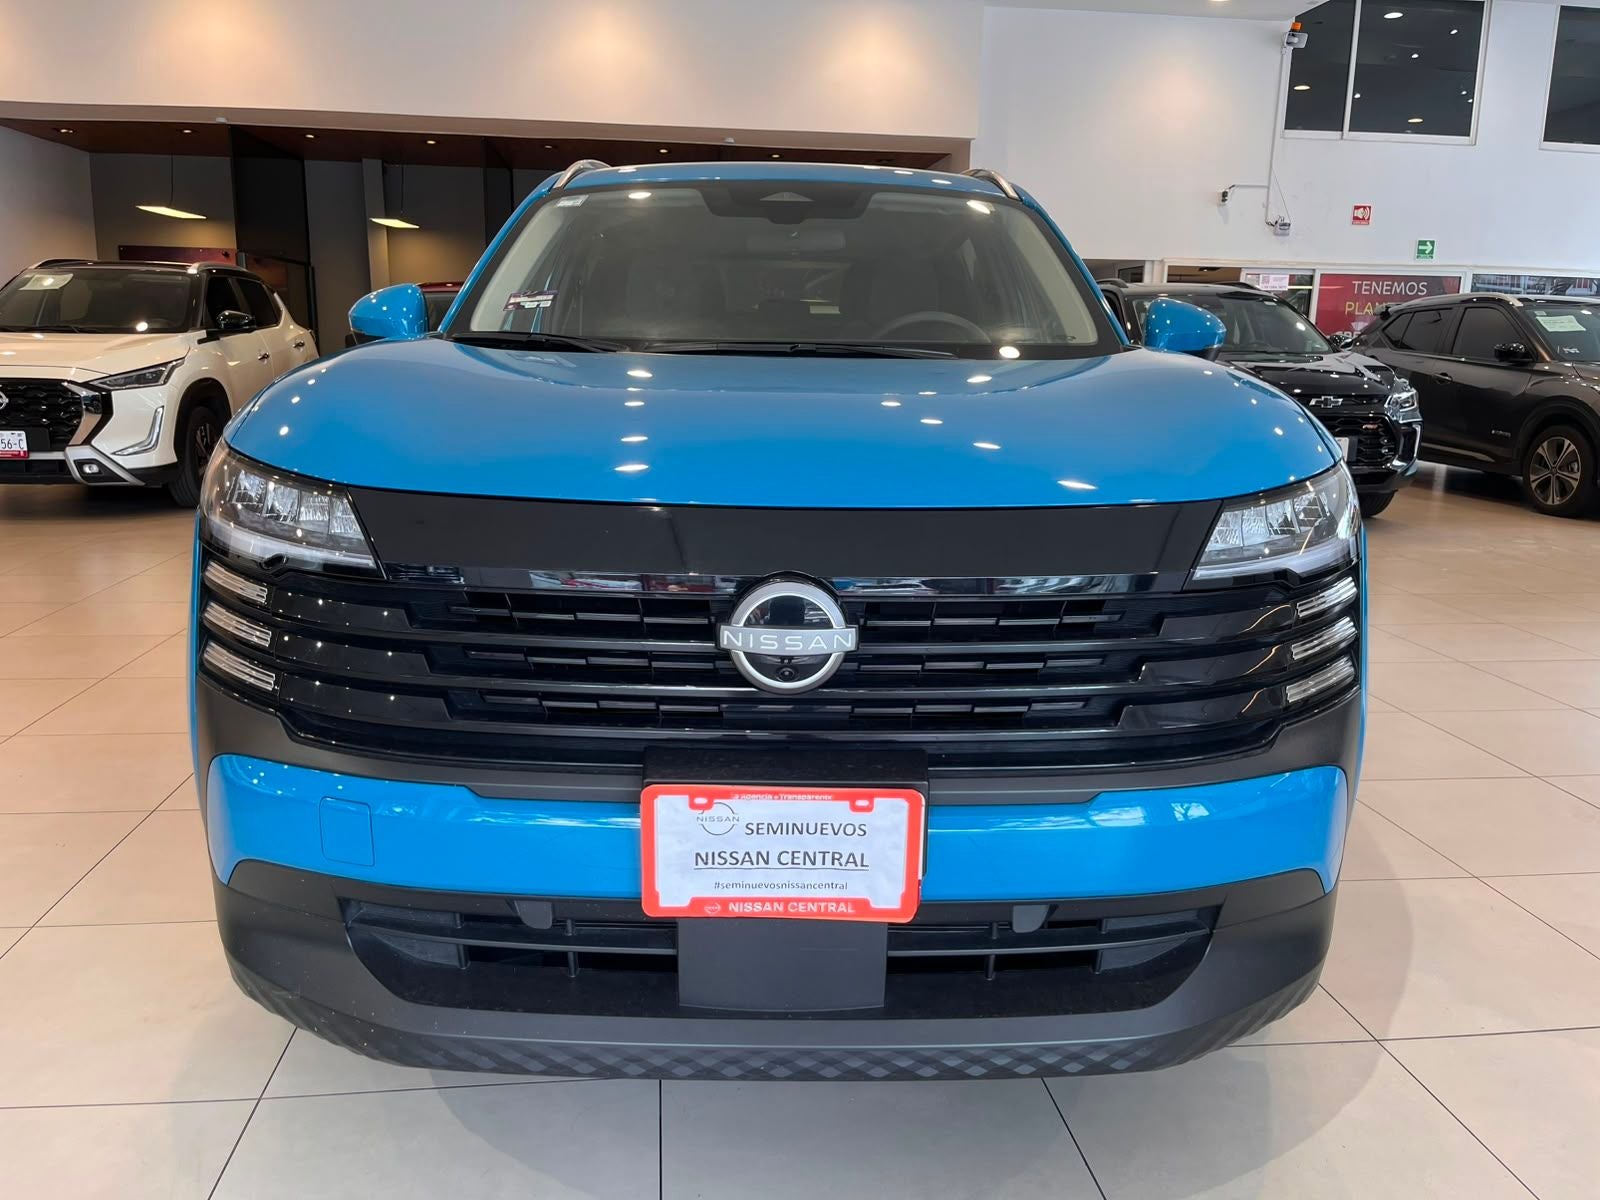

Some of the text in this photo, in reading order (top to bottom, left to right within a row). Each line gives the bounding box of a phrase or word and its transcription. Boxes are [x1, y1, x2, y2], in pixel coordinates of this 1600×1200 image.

[1352, 280, 1428, 296] TENEMOS
[723, 630, 853, 650] NISSAN
[696, 815, 740, 823] NISSAN
[744, 822, 868, 837] SEMINUEVOS
[694, 850, 870, 868] NISSAN CENTRAL
[714, 880, 848, 890] #seminuevosnissancentral
[728, 901, 784, 913] NISSAN
[787, 902, 856, 913] CENTRAL
